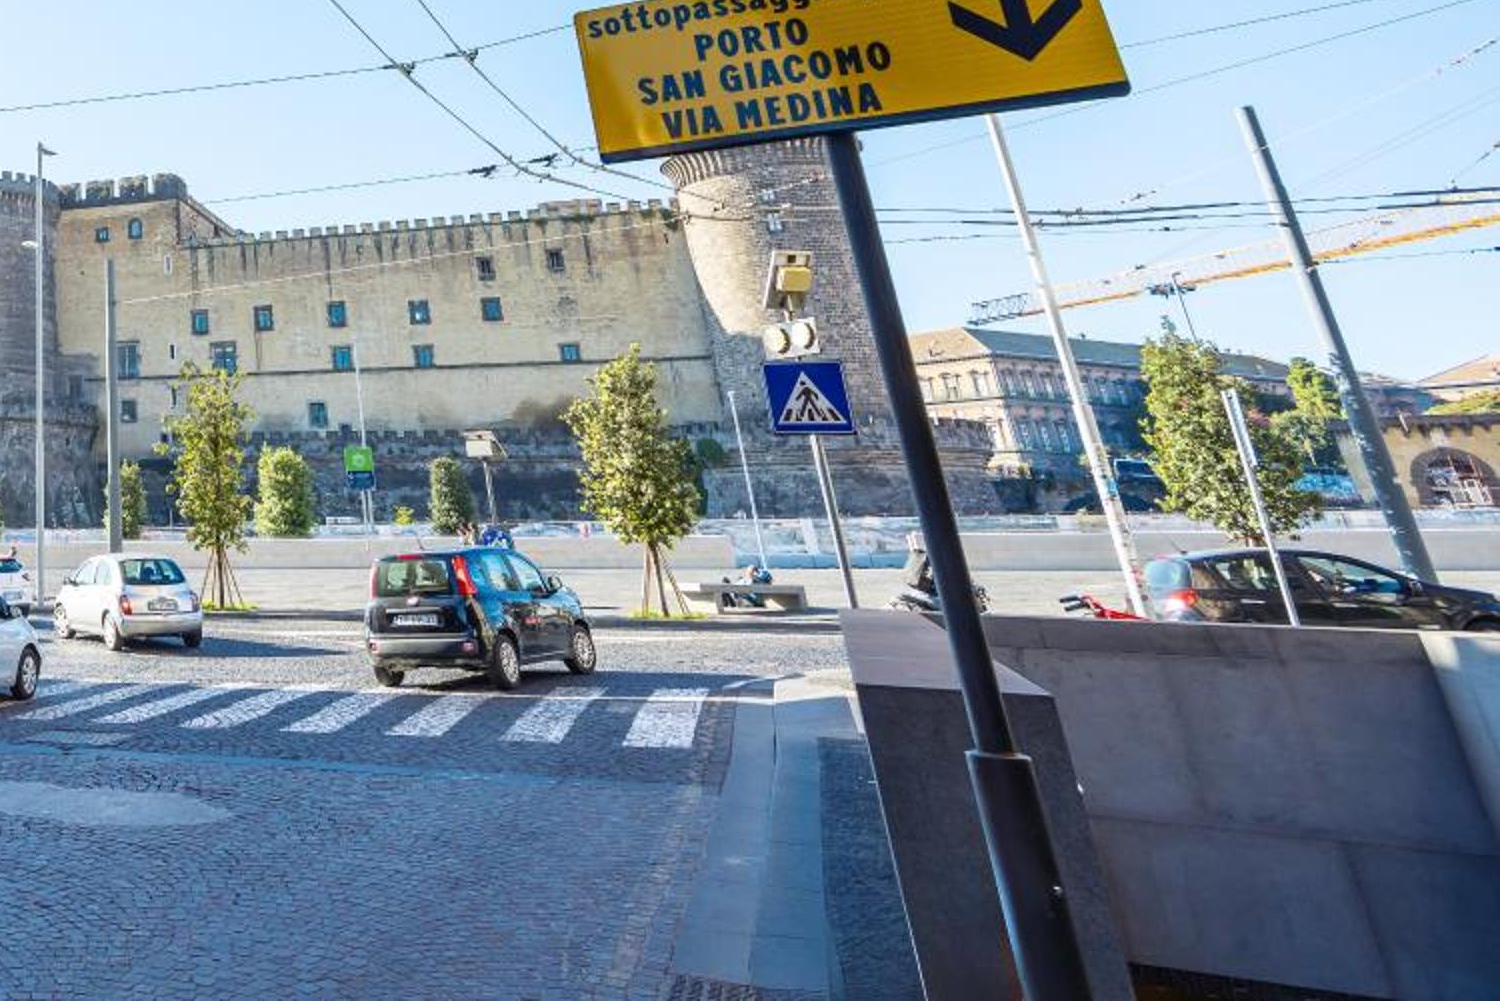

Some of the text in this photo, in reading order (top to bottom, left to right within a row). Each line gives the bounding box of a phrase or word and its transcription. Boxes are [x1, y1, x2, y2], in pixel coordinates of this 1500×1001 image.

[694, 18, 809, 61] PORTO
[638, 41, 890, 105] SAN GIACOMO
[662, 82, 882, 139] VIA MEDINA
